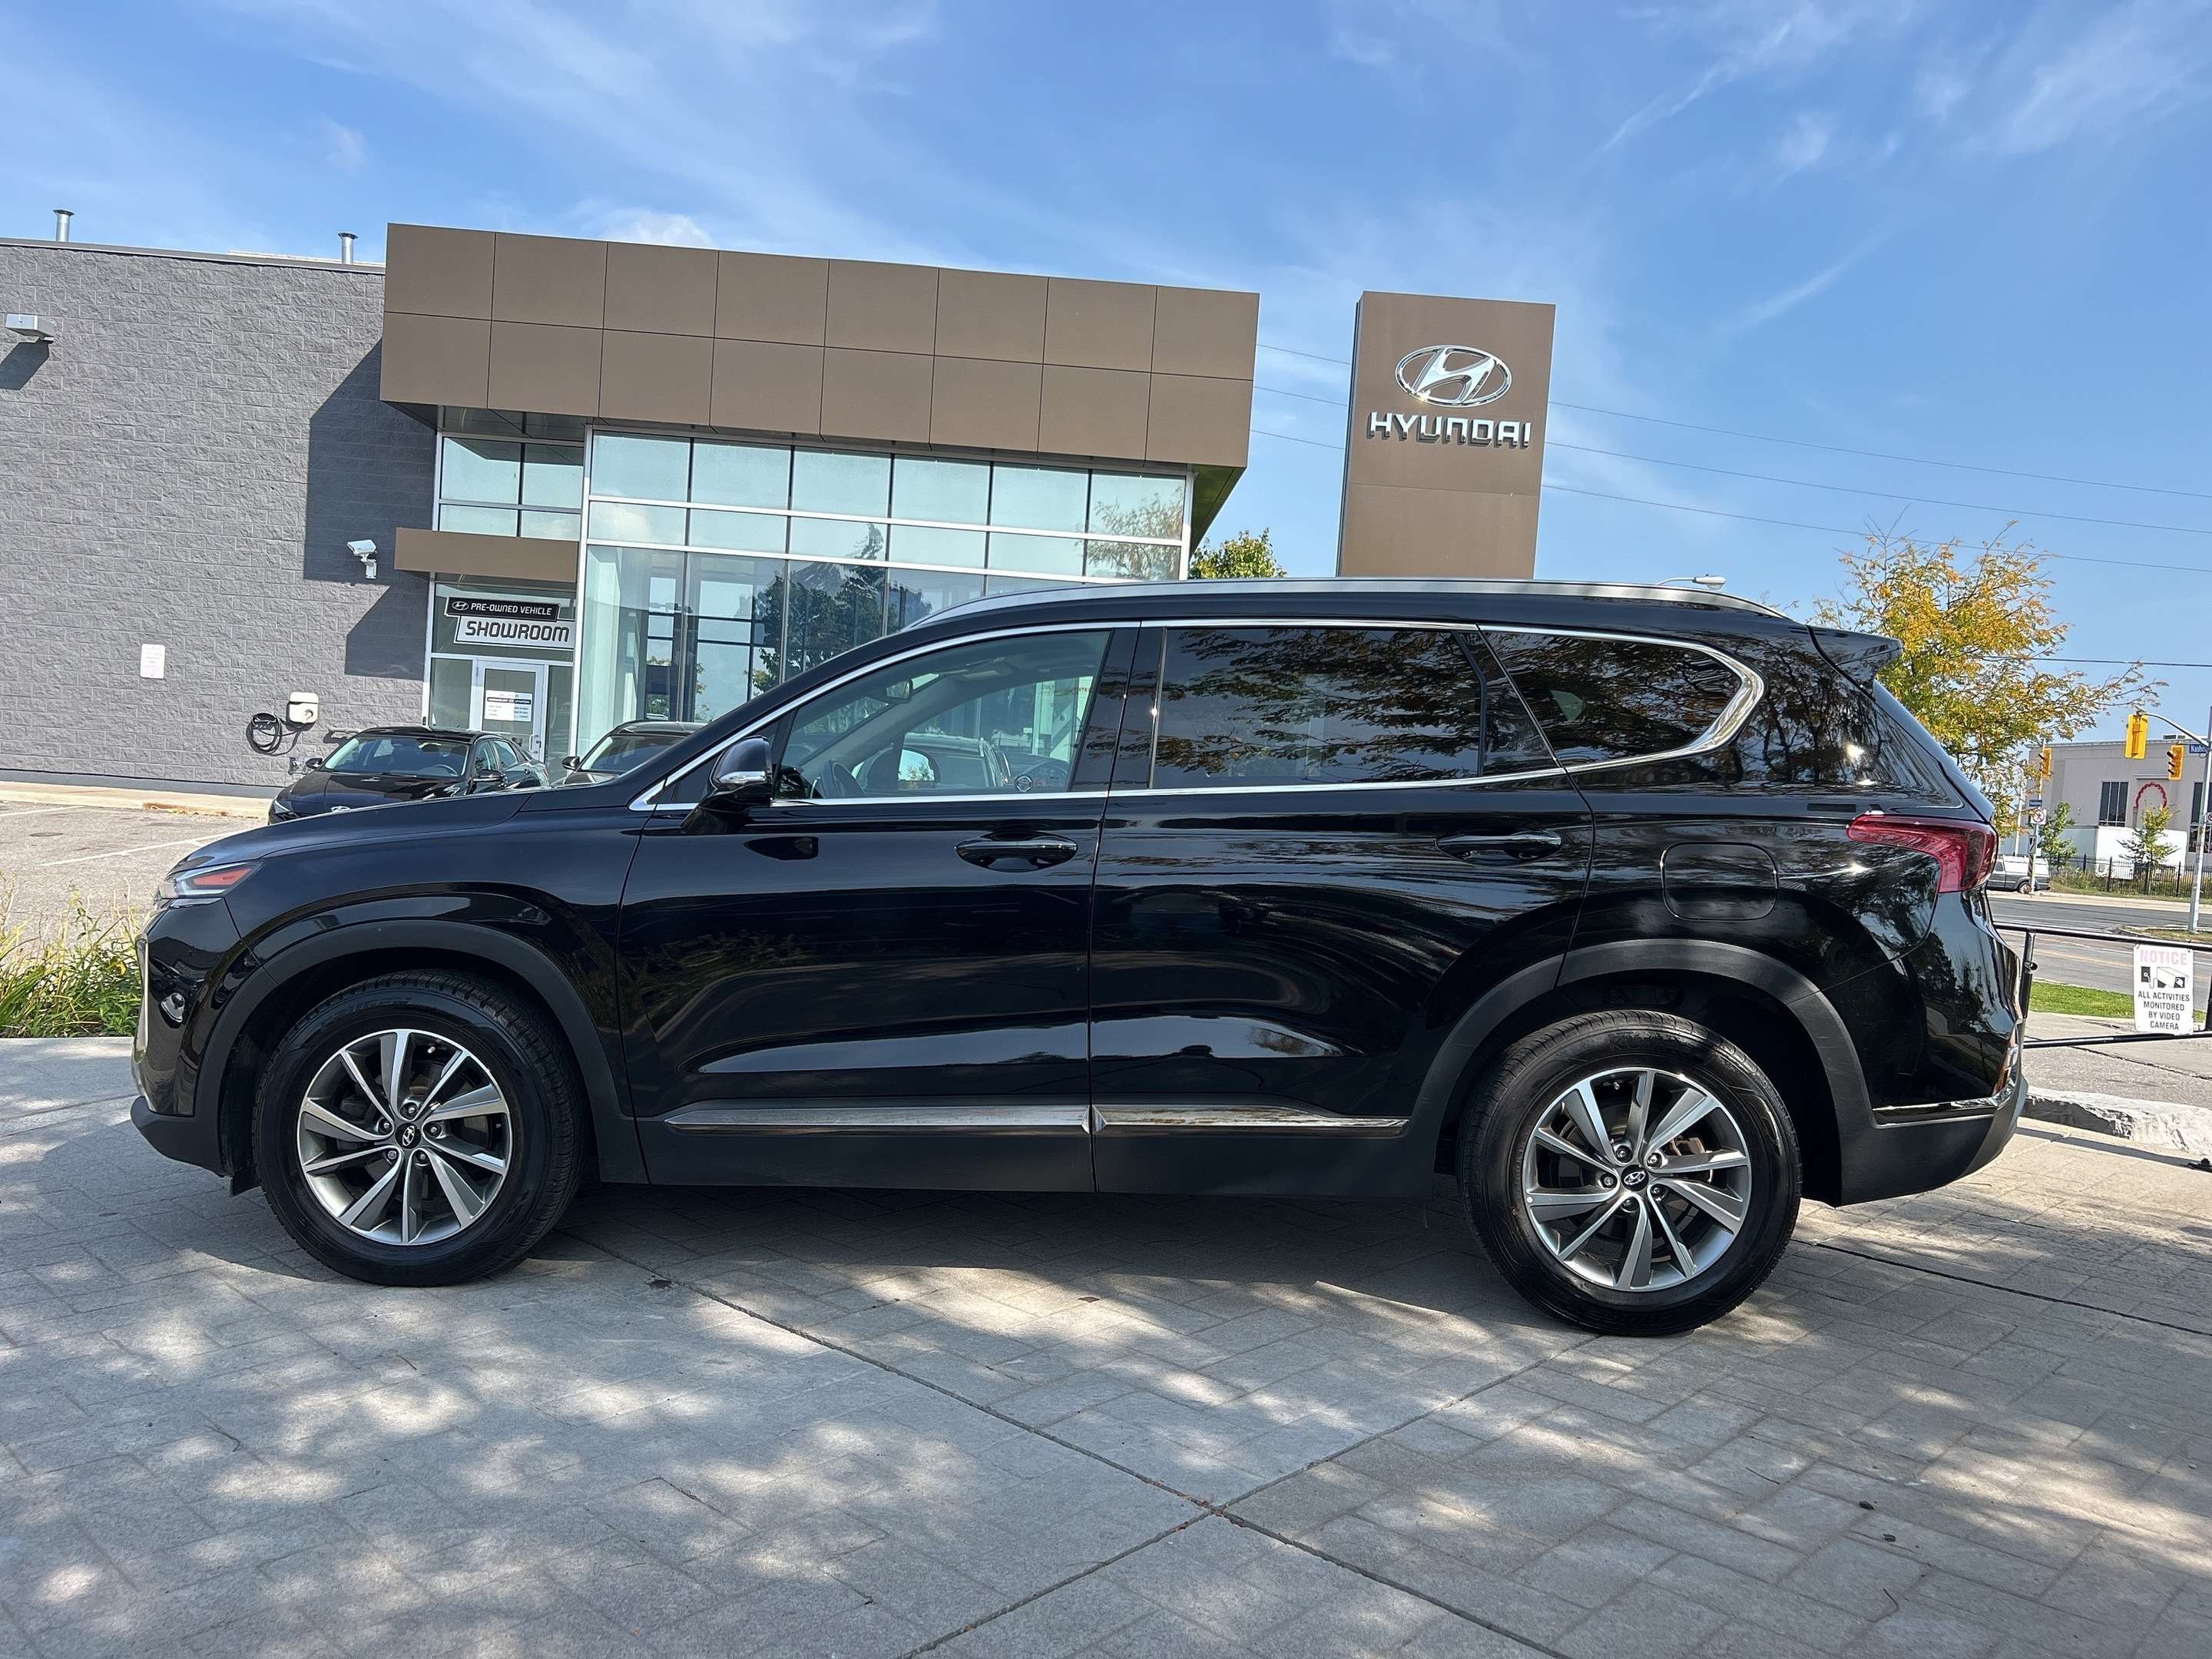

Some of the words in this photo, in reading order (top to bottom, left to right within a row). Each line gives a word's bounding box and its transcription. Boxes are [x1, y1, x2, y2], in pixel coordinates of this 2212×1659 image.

[1367, 411, 1532, 449] HYUNDAI
[470, 602, 518, 614] PRE-OWNED
[520, 605, 553, 616] VEHICLE
[465, 620, 570, 643] SHOWROOM
[2140, 949, 2188, 965] NOTICE
[2137, 990, 2151, 998] ALL
[2153, 992, 2190, 1002] ACTIVITIES
[2143, 1001, 2185, 1012] MONITORED
[2159, 1012, 2181, 1021] VIDEO
[2150, 1021, 2180, 1030] CAMERA
